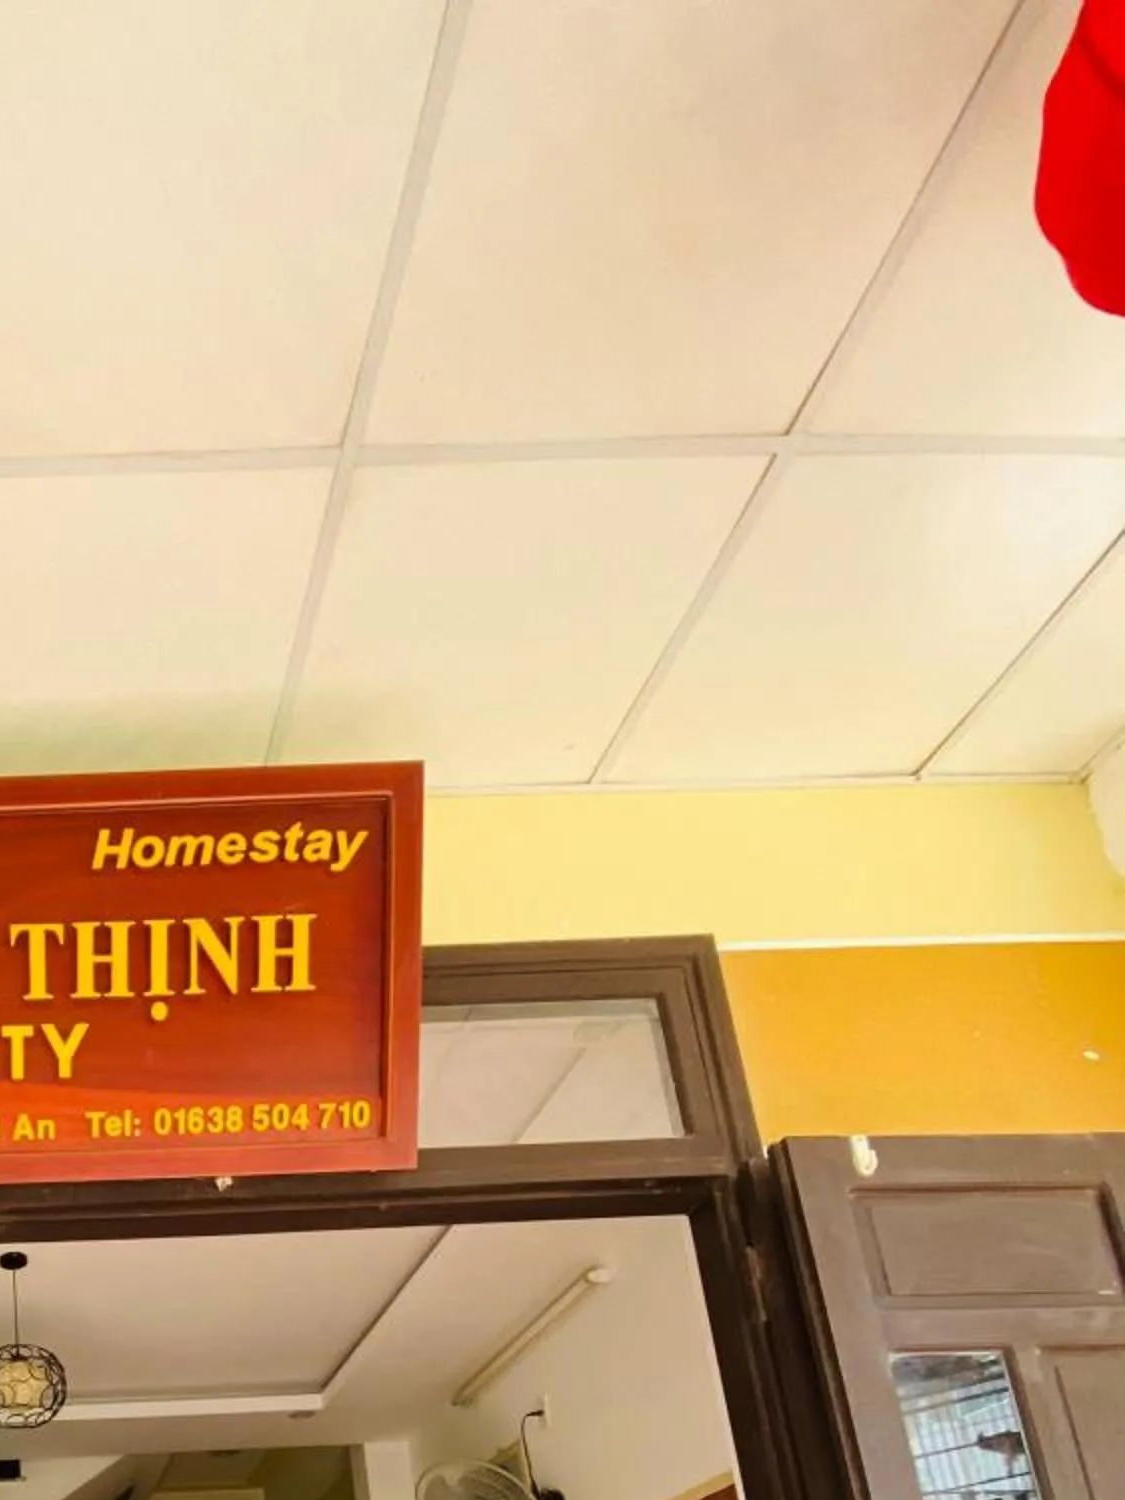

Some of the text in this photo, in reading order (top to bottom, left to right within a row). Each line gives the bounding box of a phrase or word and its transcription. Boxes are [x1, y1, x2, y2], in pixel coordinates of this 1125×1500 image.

[92, 822, 368, 872] Homestay
[11, 913, 317, 1021] THỊNH
[12, 1113, 56, 1141] An
[84, 1100, 371, 1139] Tel: 01638 504 710
